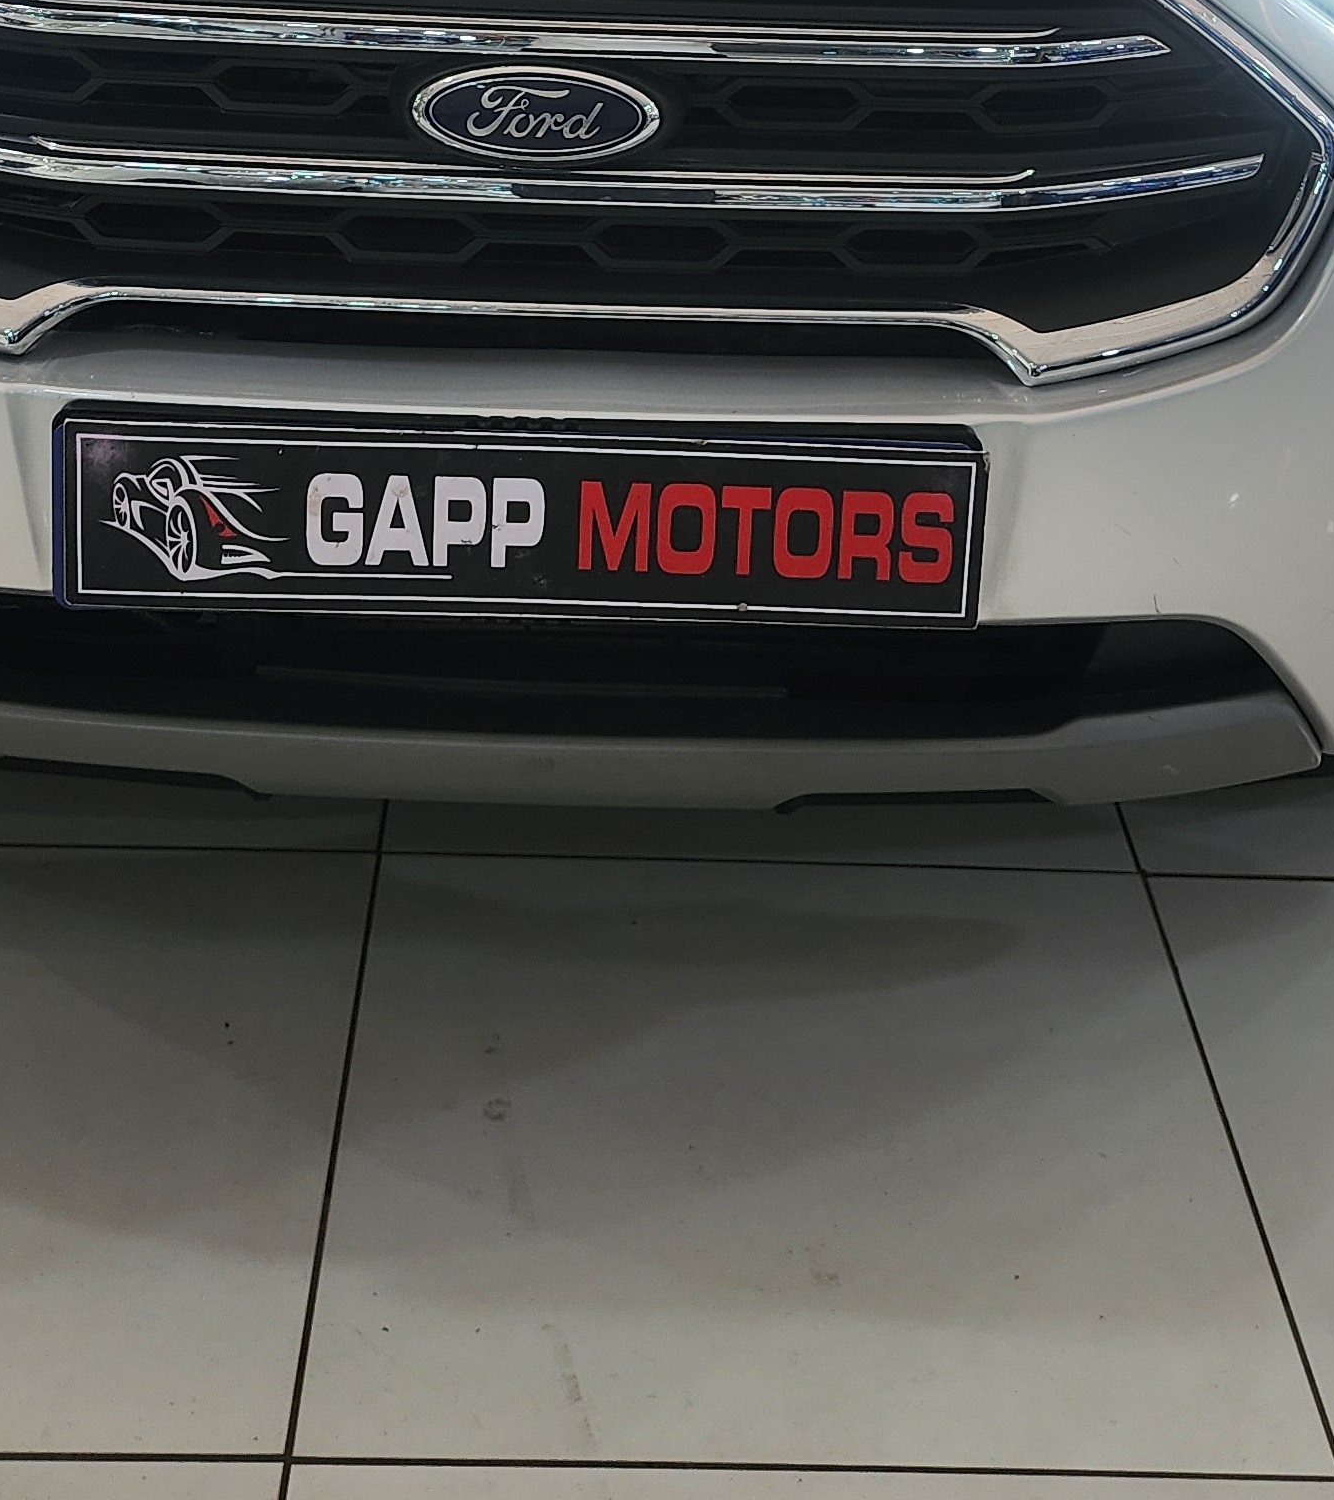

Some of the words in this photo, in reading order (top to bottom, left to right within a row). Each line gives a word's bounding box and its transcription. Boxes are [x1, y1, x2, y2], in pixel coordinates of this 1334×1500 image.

[466, 85, 604, 139] Ford
[305, 472, 546, 568] GAPP
[578, 481, 955, 583] MOTORS
